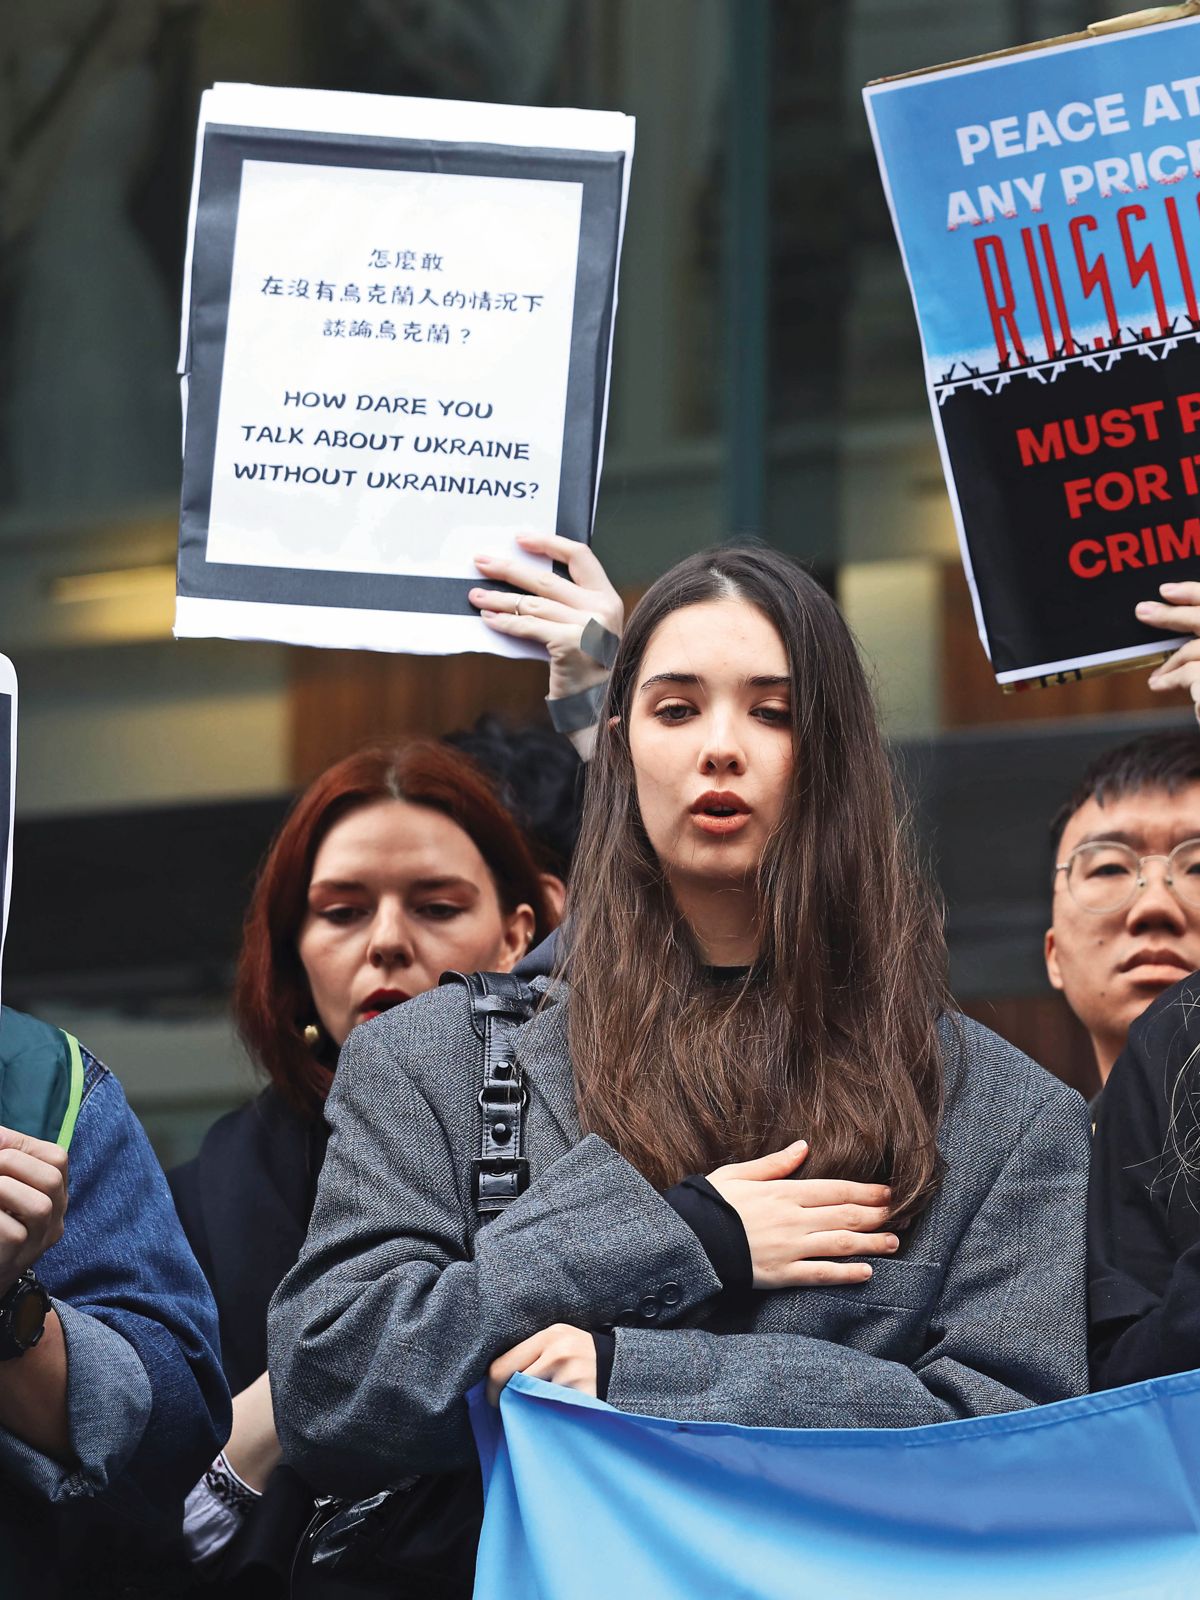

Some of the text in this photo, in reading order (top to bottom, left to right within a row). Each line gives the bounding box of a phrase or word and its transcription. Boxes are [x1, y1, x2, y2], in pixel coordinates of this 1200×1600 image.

[956, 93, 1130, 166] PEACE
[947, 173, 1047, 231] ANY
[368, 249, 444, 271] 怎麼敢
[284, 391, 493, 419] HOW DARE YOU
[241, 425, 530, 460] TALK ABOUT UKRAINE
[1016, 400, 1164, 467] MUST
[234, 462, 539, 499] WITHOUT UKRAINIANS?
[1064, 464, 1173, 519] FOR
